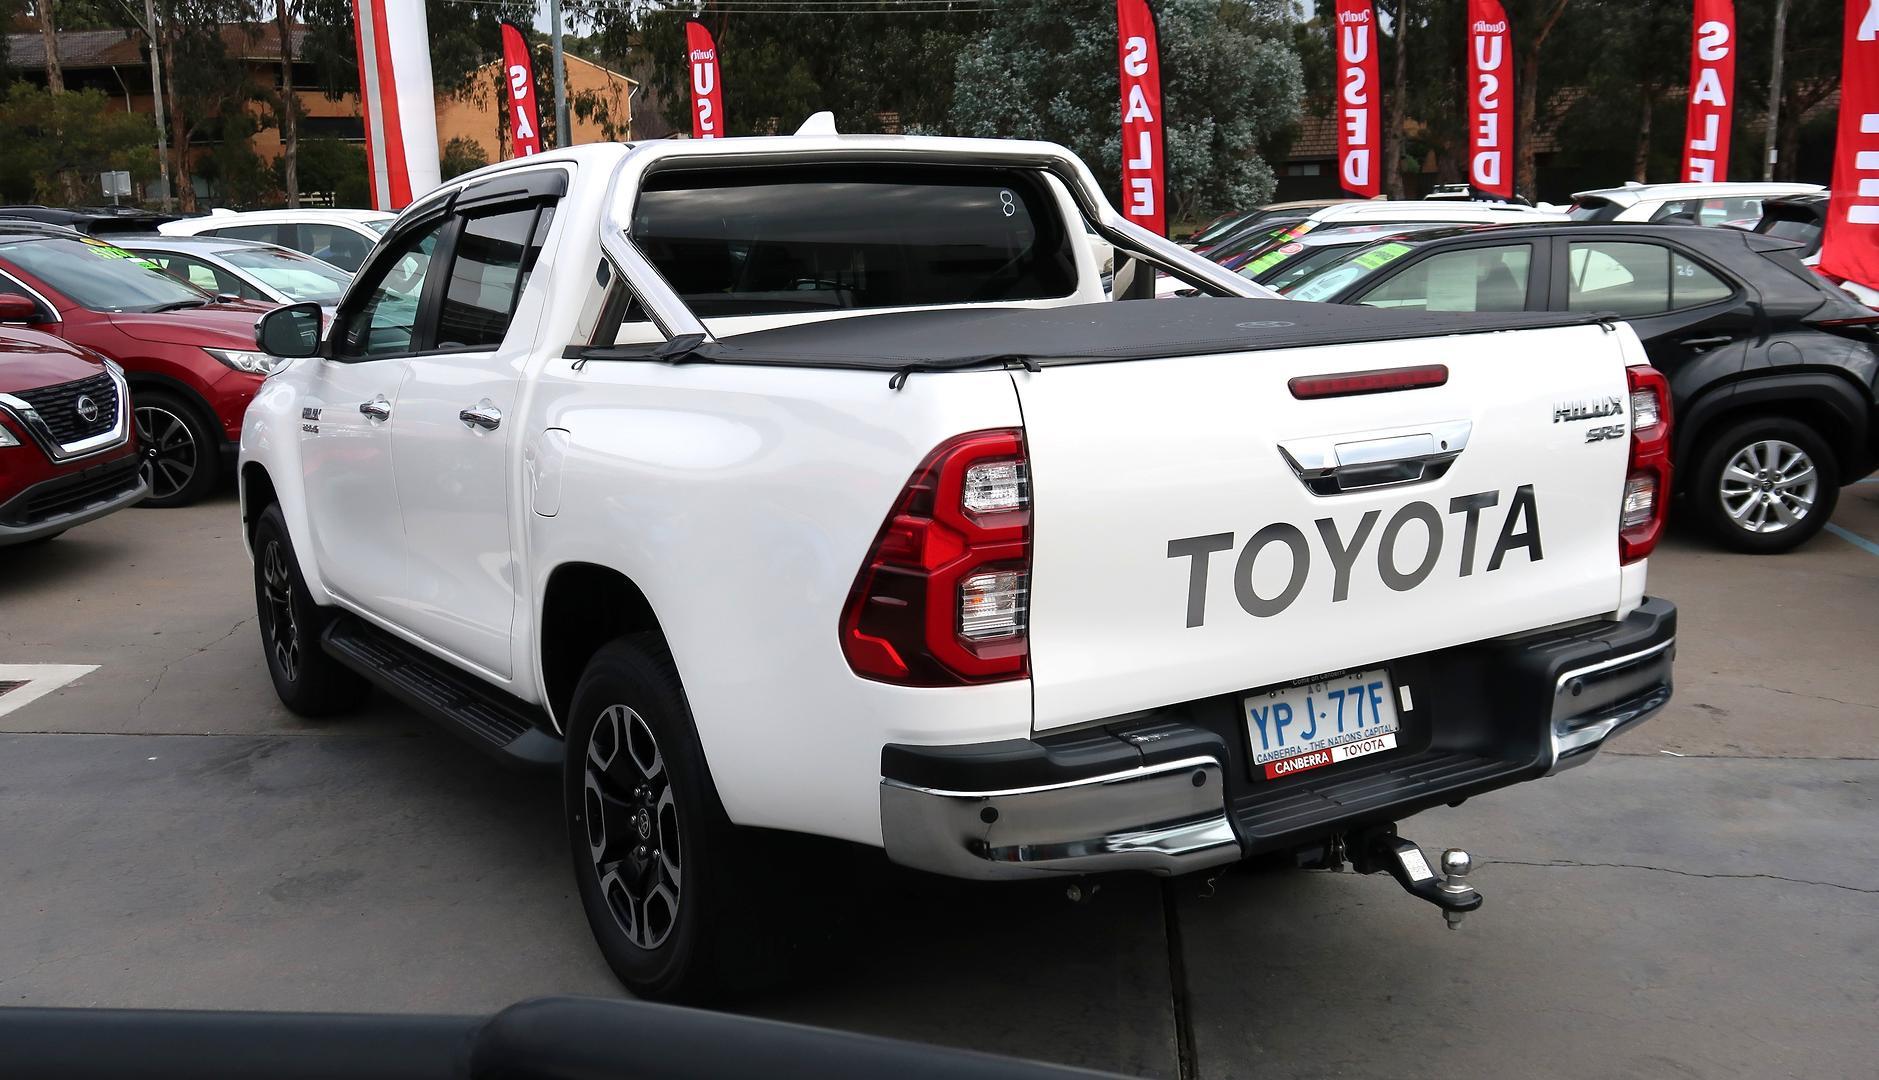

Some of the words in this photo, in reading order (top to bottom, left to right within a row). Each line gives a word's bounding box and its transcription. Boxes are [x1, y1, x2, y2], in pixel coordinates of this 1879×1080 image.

[1000, 190, 1015, 217] 8
[1552, 395, 1624, 424] HILUX
[1584, 423, 1626, 444] SR5
[1167, 483, 1543, 629] TOYOTA
[1256, 746, 1302, 764] CANBERRA
[1310, 738, 1326, 750] THE
[1364, 724, 1394, 738] CAPITAL
[1275, 751, 1330, 775] CANBERRA
[1343, 738, 1386, 758] TOYOTA
